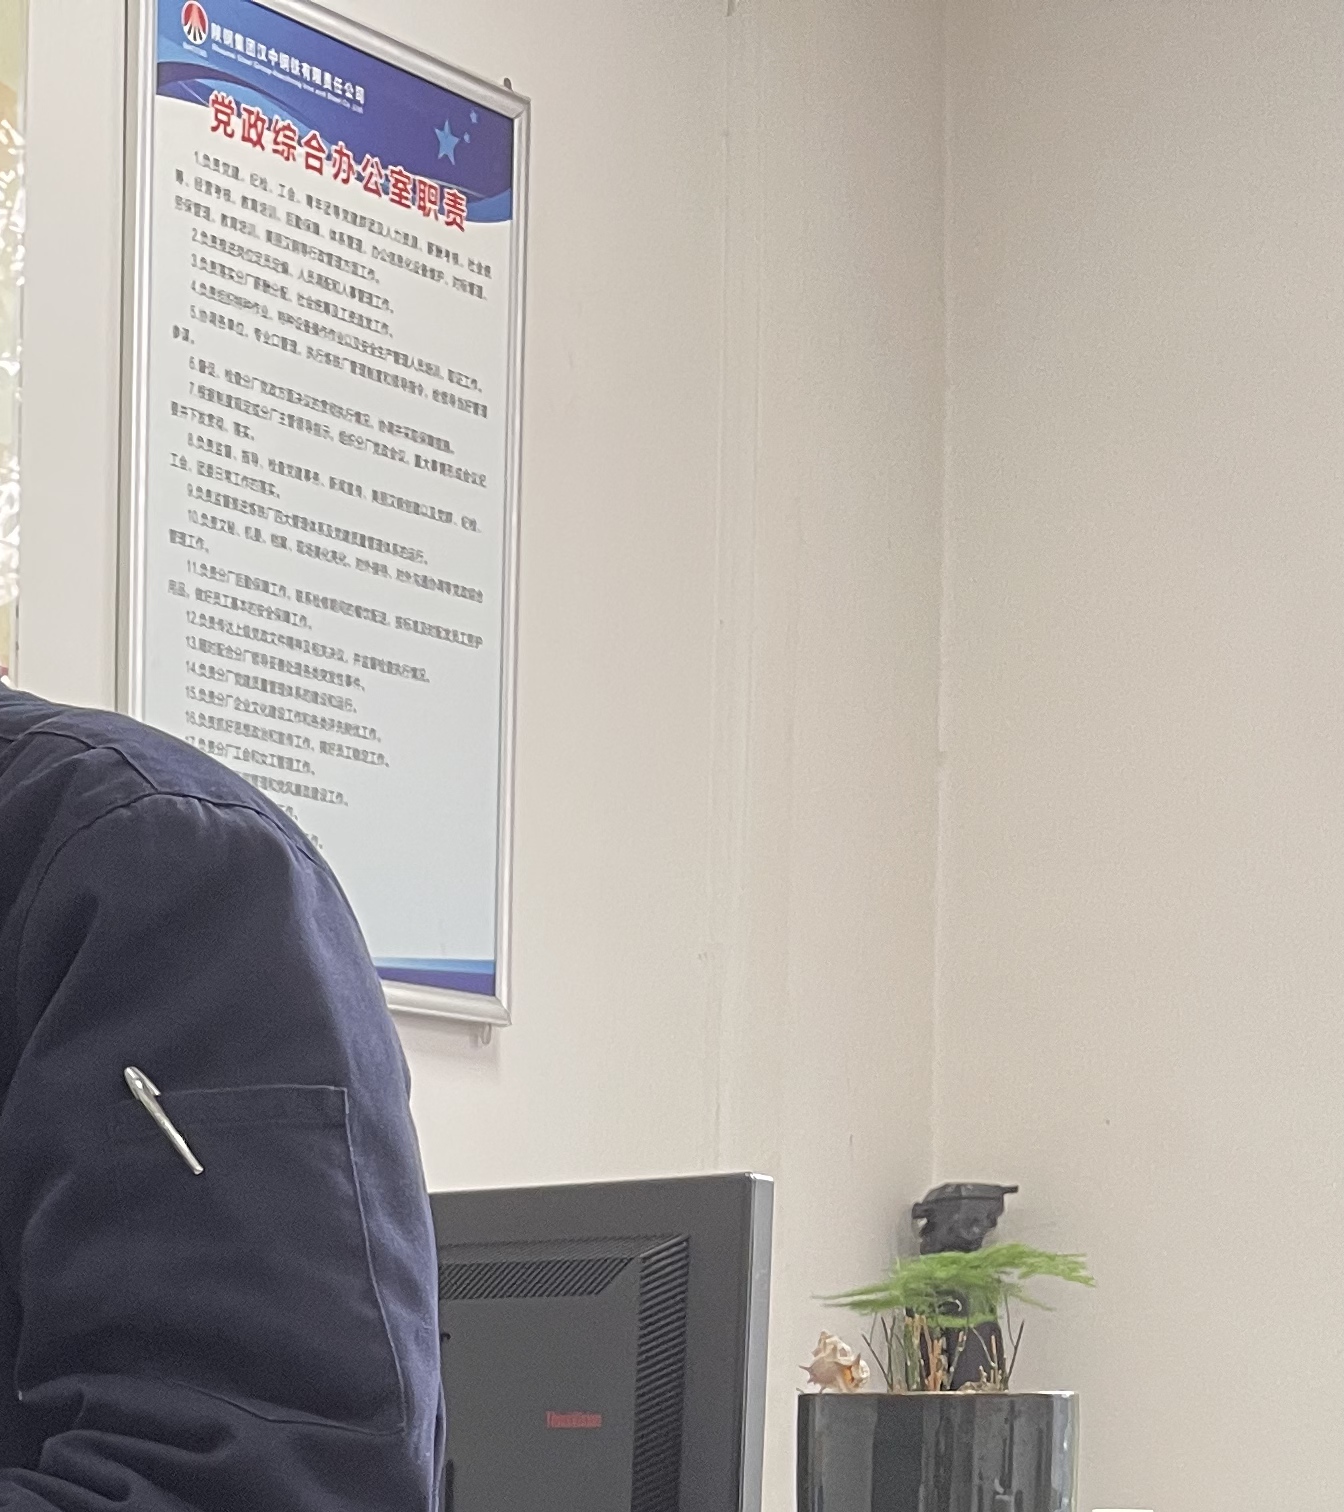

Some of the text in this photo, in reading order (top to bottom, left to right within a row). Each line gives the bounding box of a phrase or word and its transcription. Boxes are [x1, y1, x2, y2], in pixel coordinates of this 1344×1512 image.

[208, 89, 468, 233] 党政综合办公室职责
